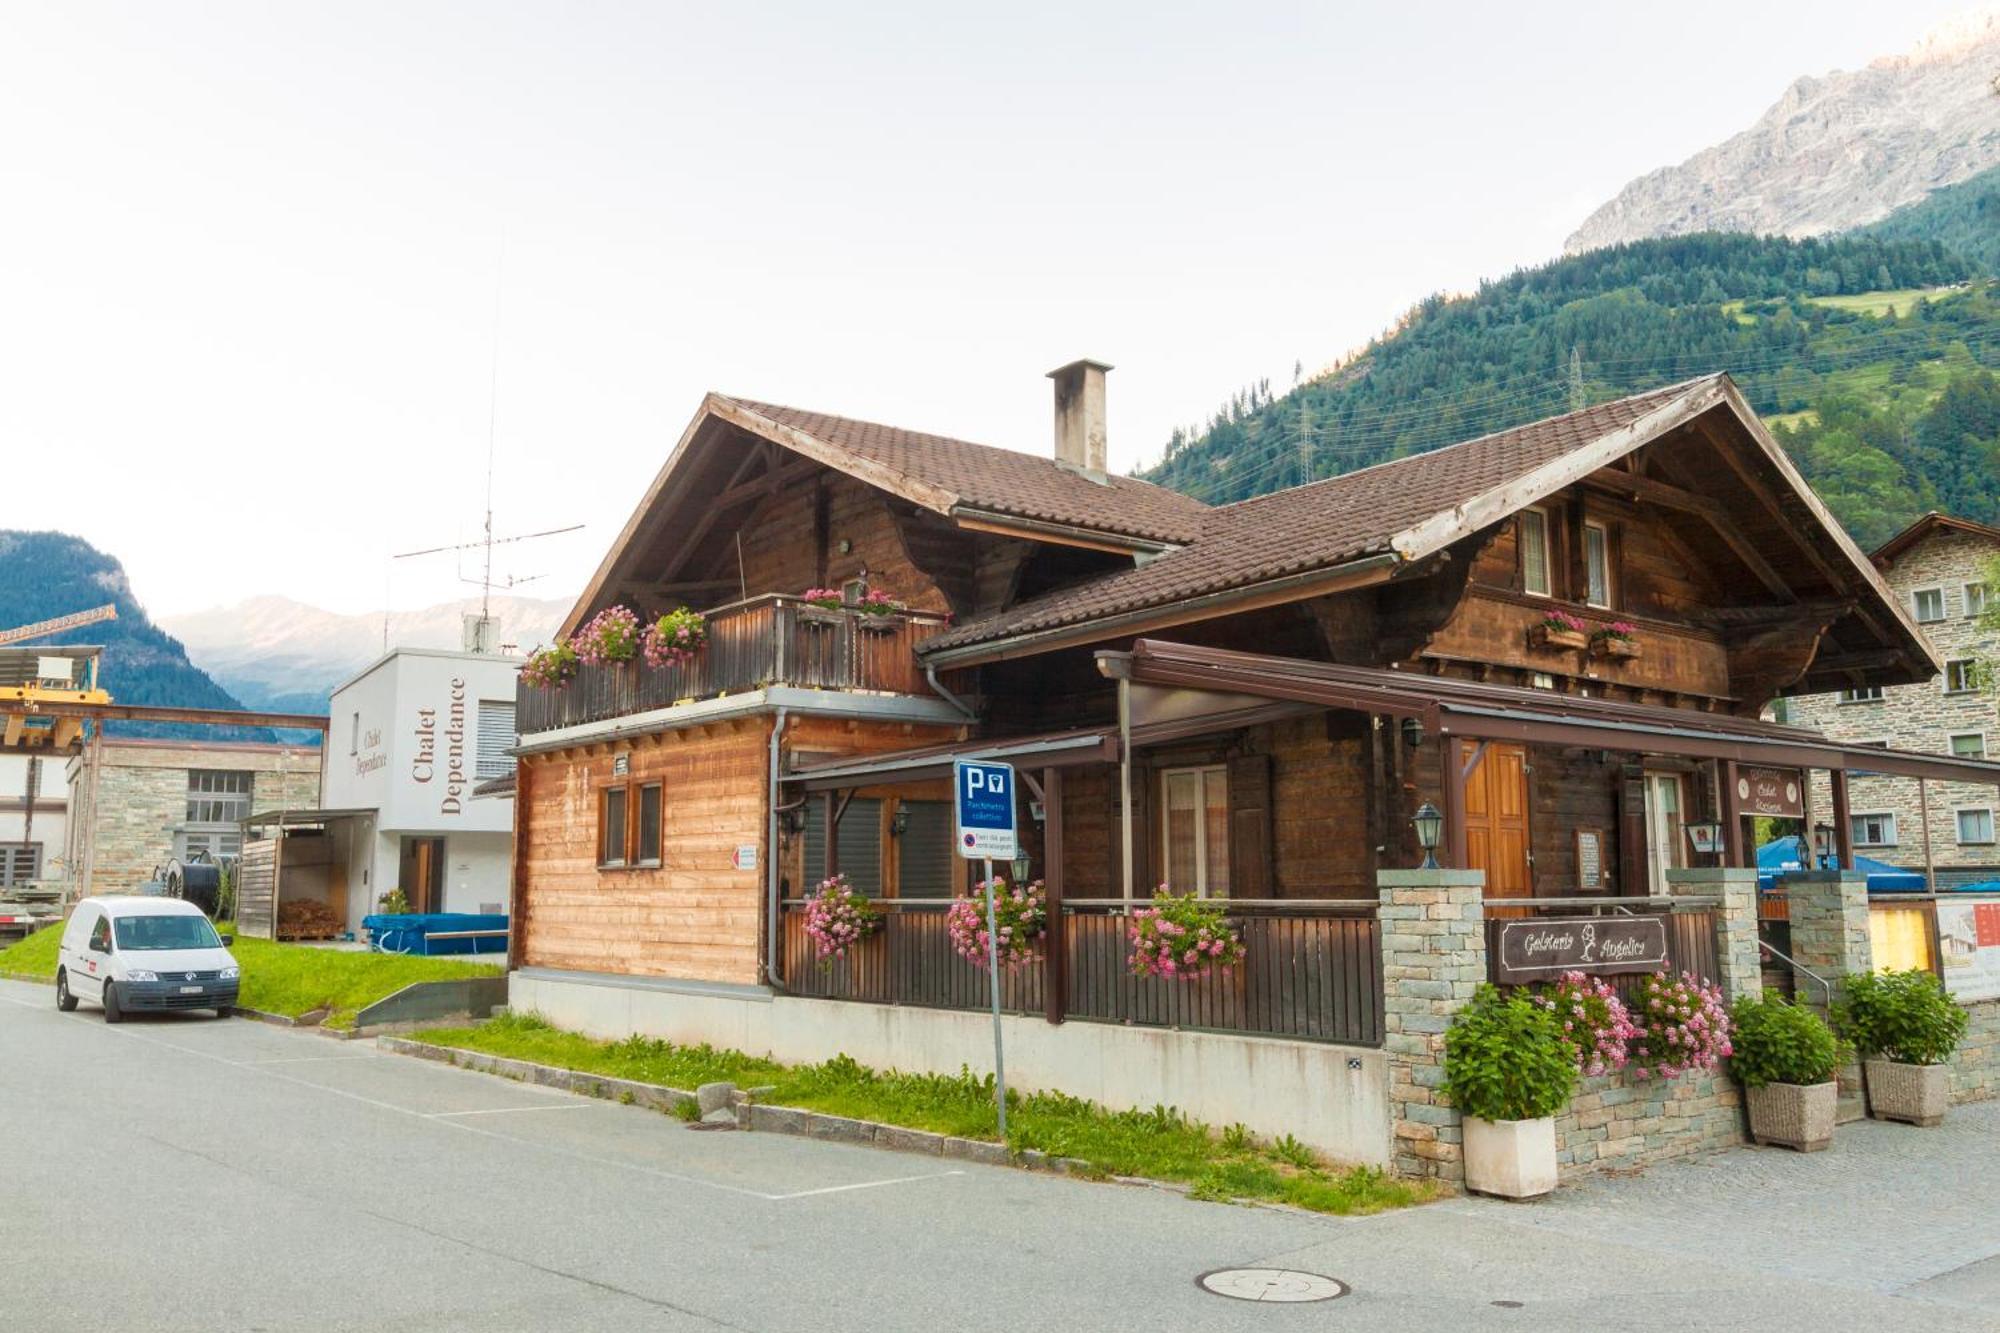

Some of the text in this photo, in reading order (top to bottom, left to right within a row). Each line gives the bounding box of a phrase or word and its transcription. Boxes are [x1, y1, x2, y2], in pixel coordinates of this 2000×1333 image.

[412, 709, 436, 783] Chalet
[441, 677, 467, 816] Dependance
[967, 767, 984, 799] P
[1524, 931, 1645, 960] Gelateria Angelica
